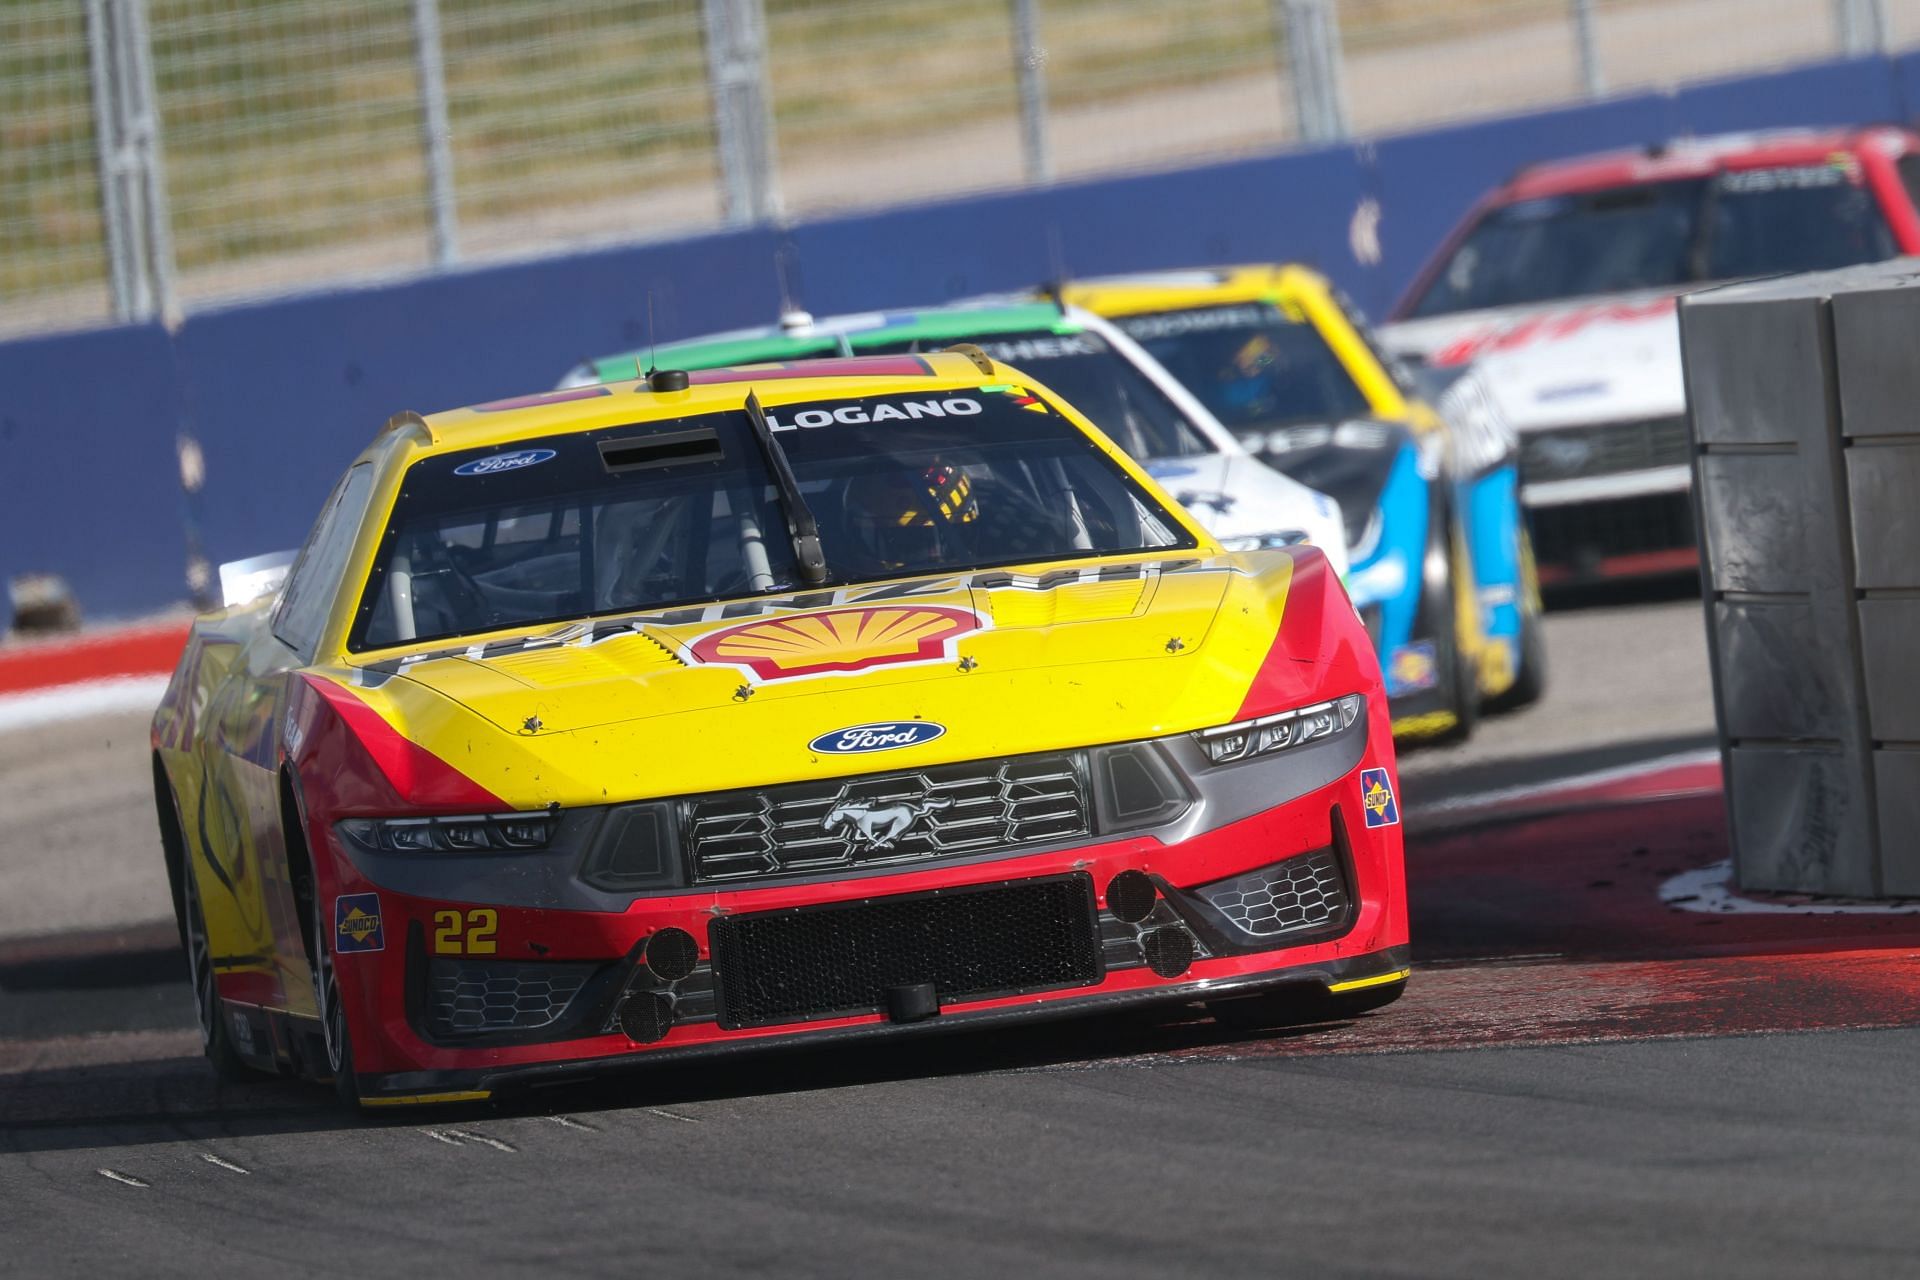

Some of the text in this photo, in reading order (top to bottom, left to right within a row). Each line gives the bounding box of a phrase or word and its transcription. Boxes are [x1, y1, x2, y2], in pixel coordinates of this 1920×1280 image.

[766, 398, 983, 432] LOGANO
[474, 453, 537, 473] Ford
[836, 725, 918, 751] Ford
[341, 917, 378, 933] SUNOCO
[435, 908, 498, 954] 22
